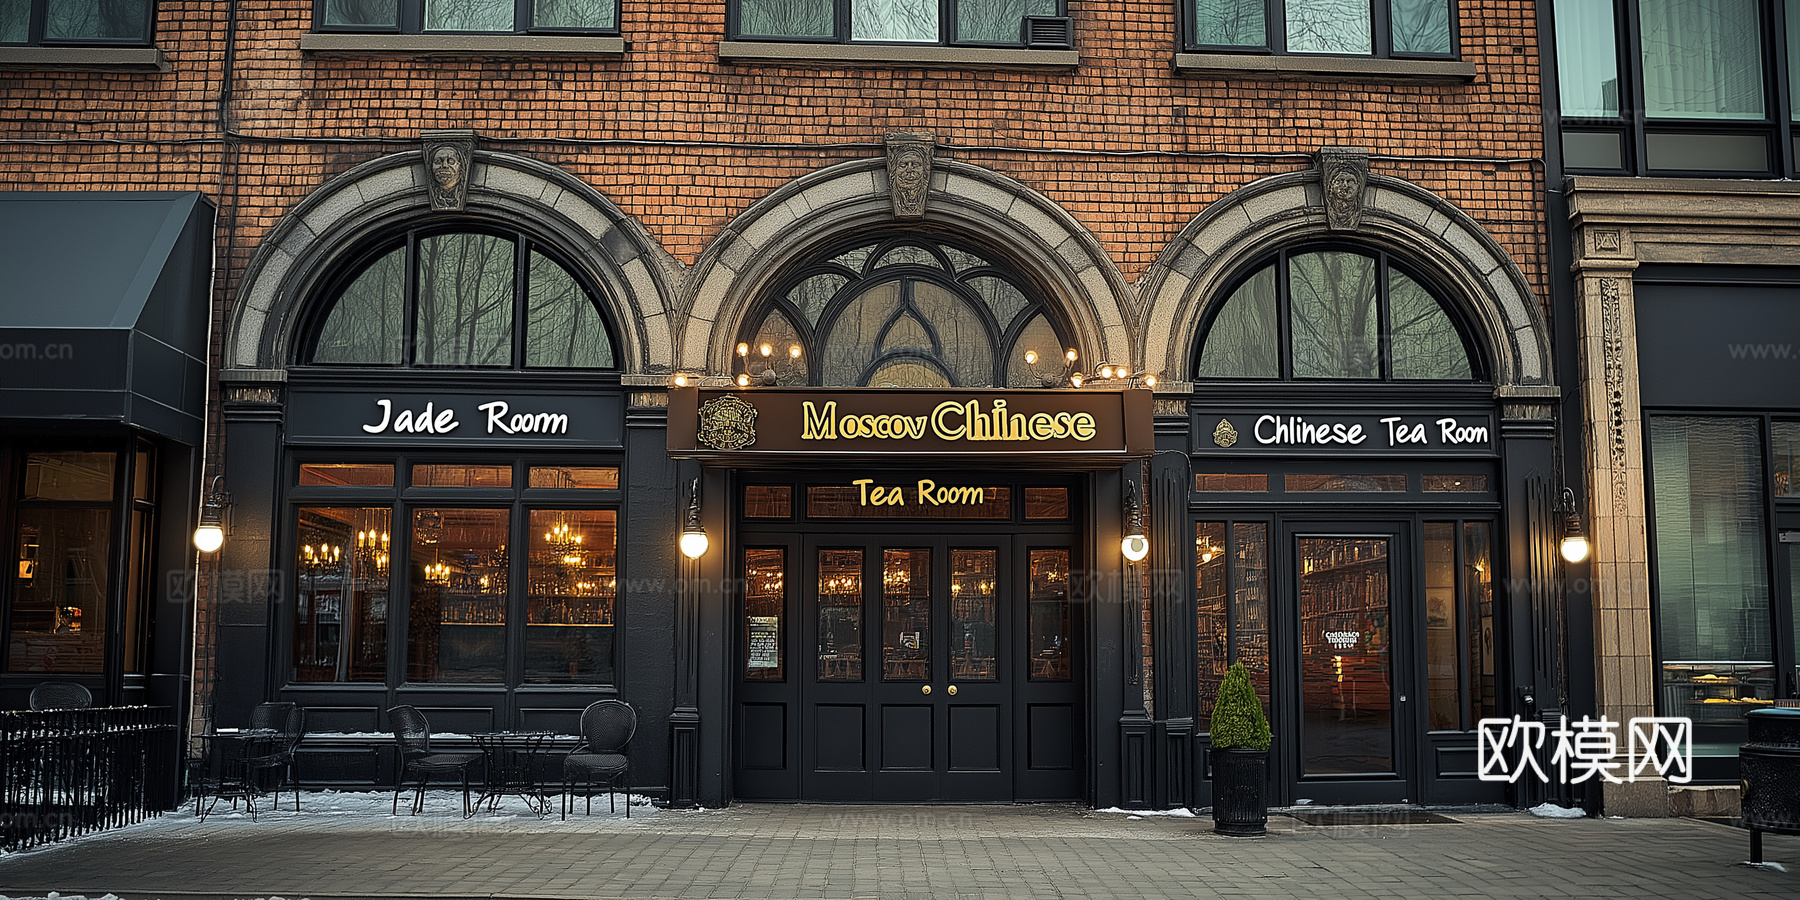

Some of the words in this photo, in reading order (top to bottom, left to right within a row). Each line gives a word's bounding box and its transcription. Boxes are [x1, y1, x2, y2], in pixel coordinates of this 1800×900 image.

[362, 399, 460, 434] Jade
[477, 400, 568, 434] Room
[930, 399, 1097, 441] Chinese
[1254, 414, 1367, 445] Chlinese
[1379, 416, 1428, 447] Tea
[852, 478, 905, 507] Tea
[917, 479, 984, 506] Room
